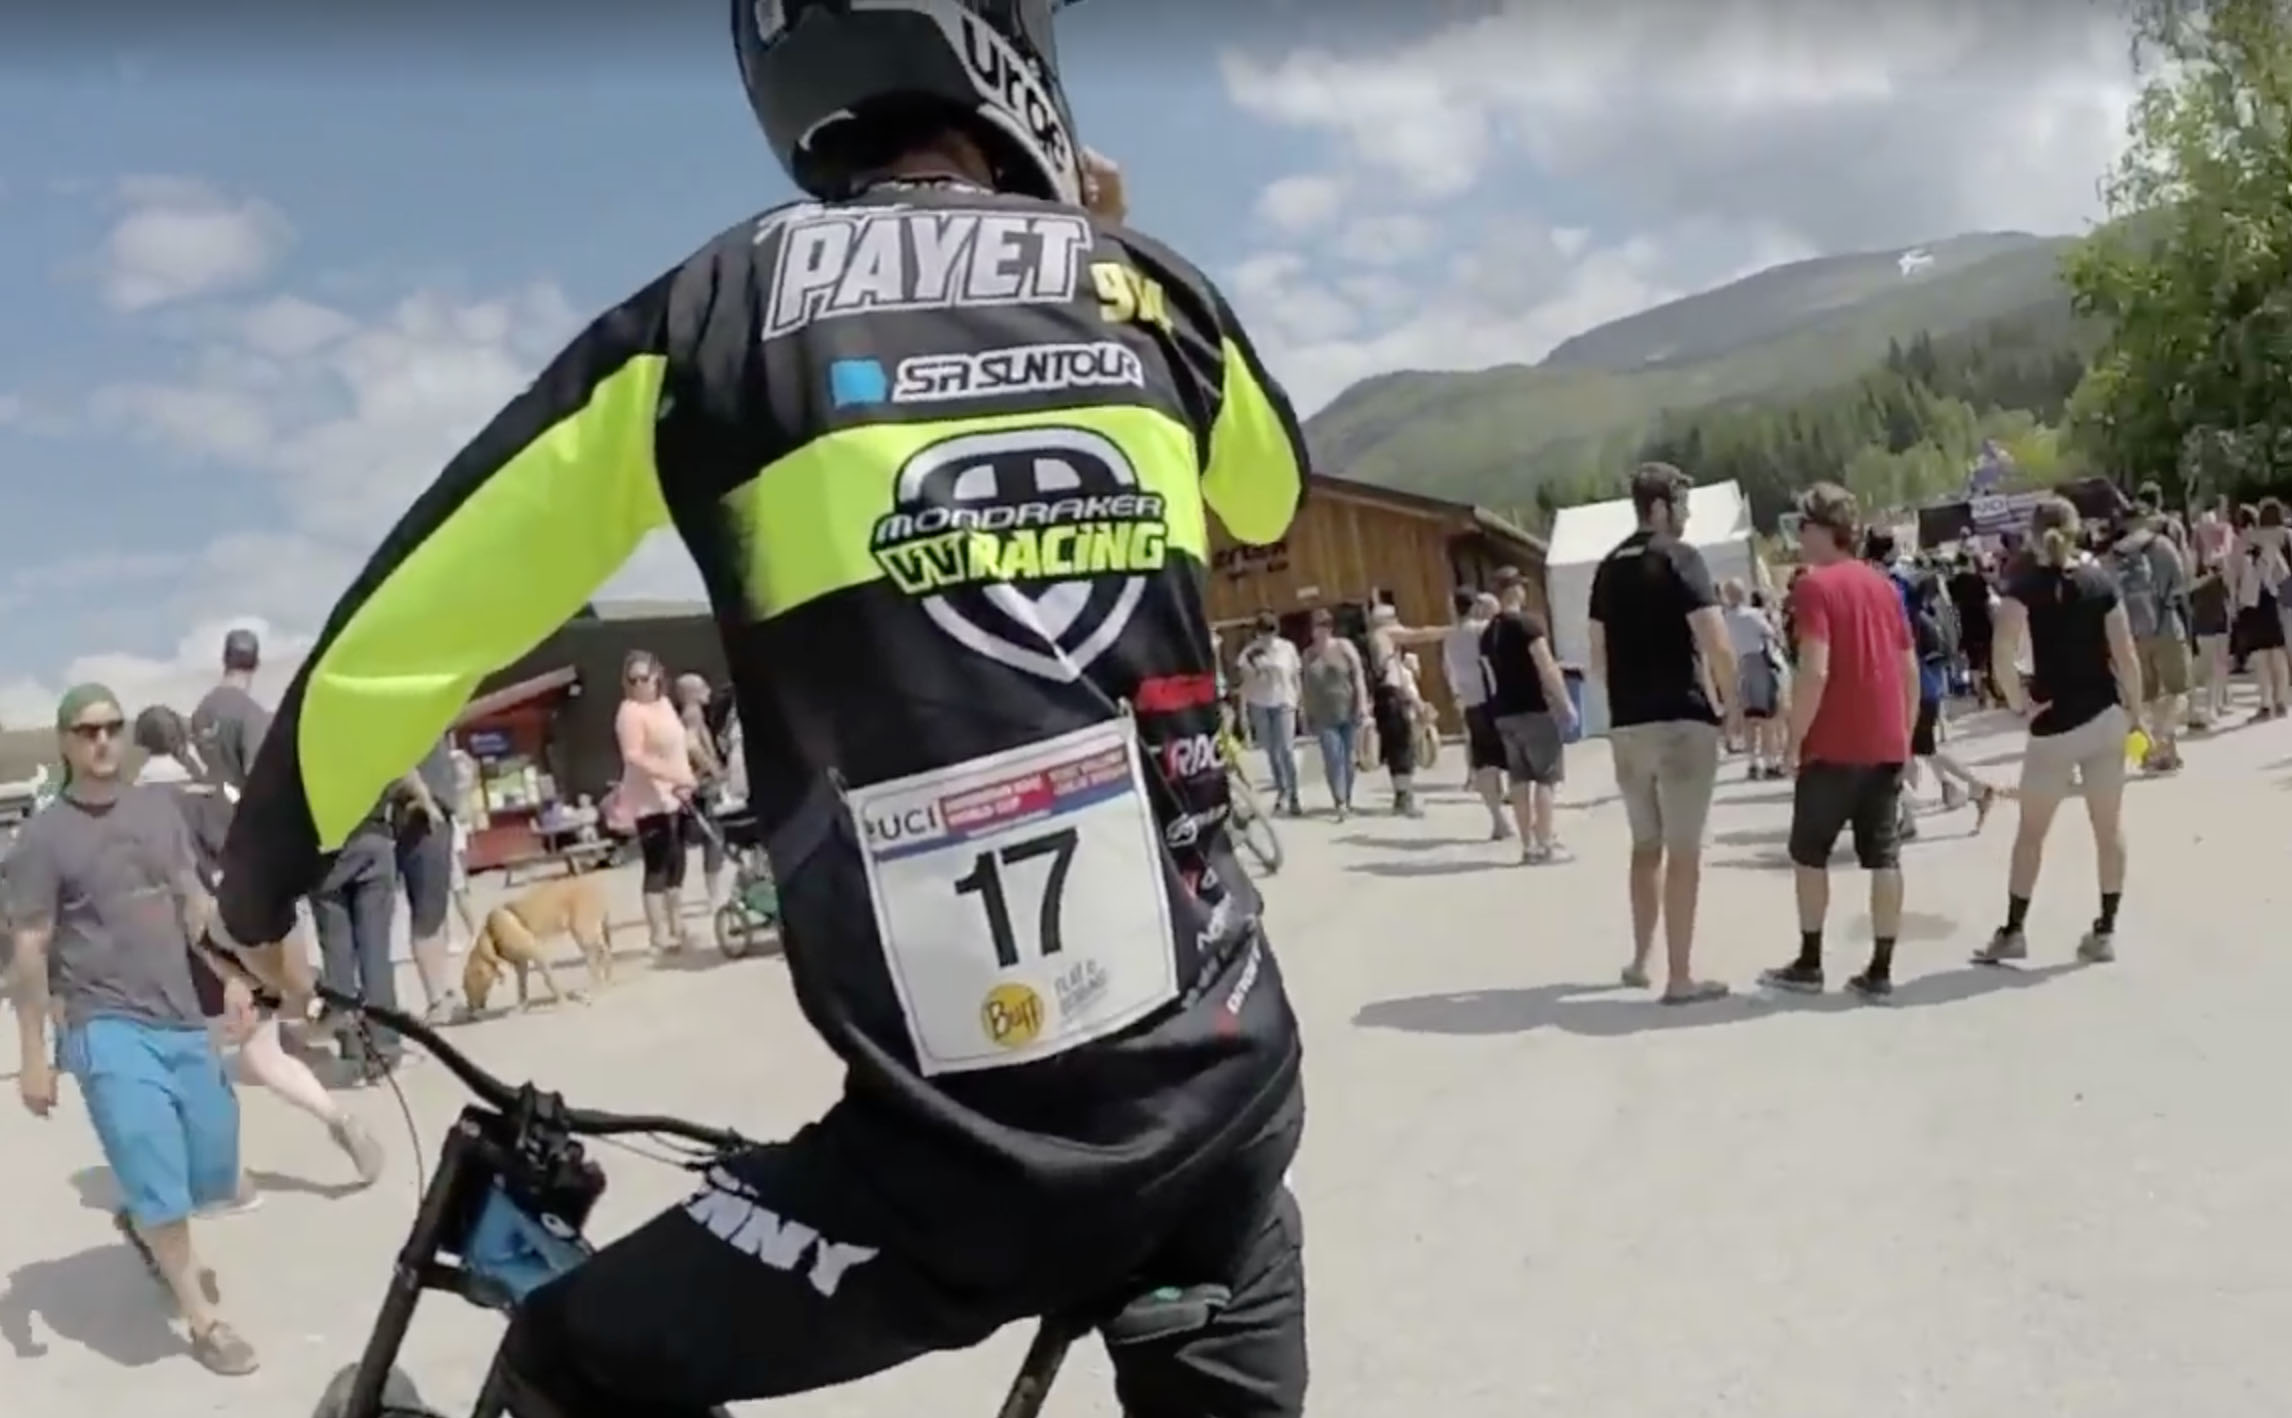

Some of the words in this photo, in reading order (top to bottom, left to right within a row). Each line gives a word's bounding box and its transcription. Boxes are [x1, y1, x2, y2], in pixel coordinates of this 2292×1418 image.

[763, 212, 1091, 340] PAYET
[899, 360, 971, 396] SR
[878, 804, 937, 840] UCI
[954, 826, 1079, 969] 17
[988, 992, 1041, 1040] Buff
